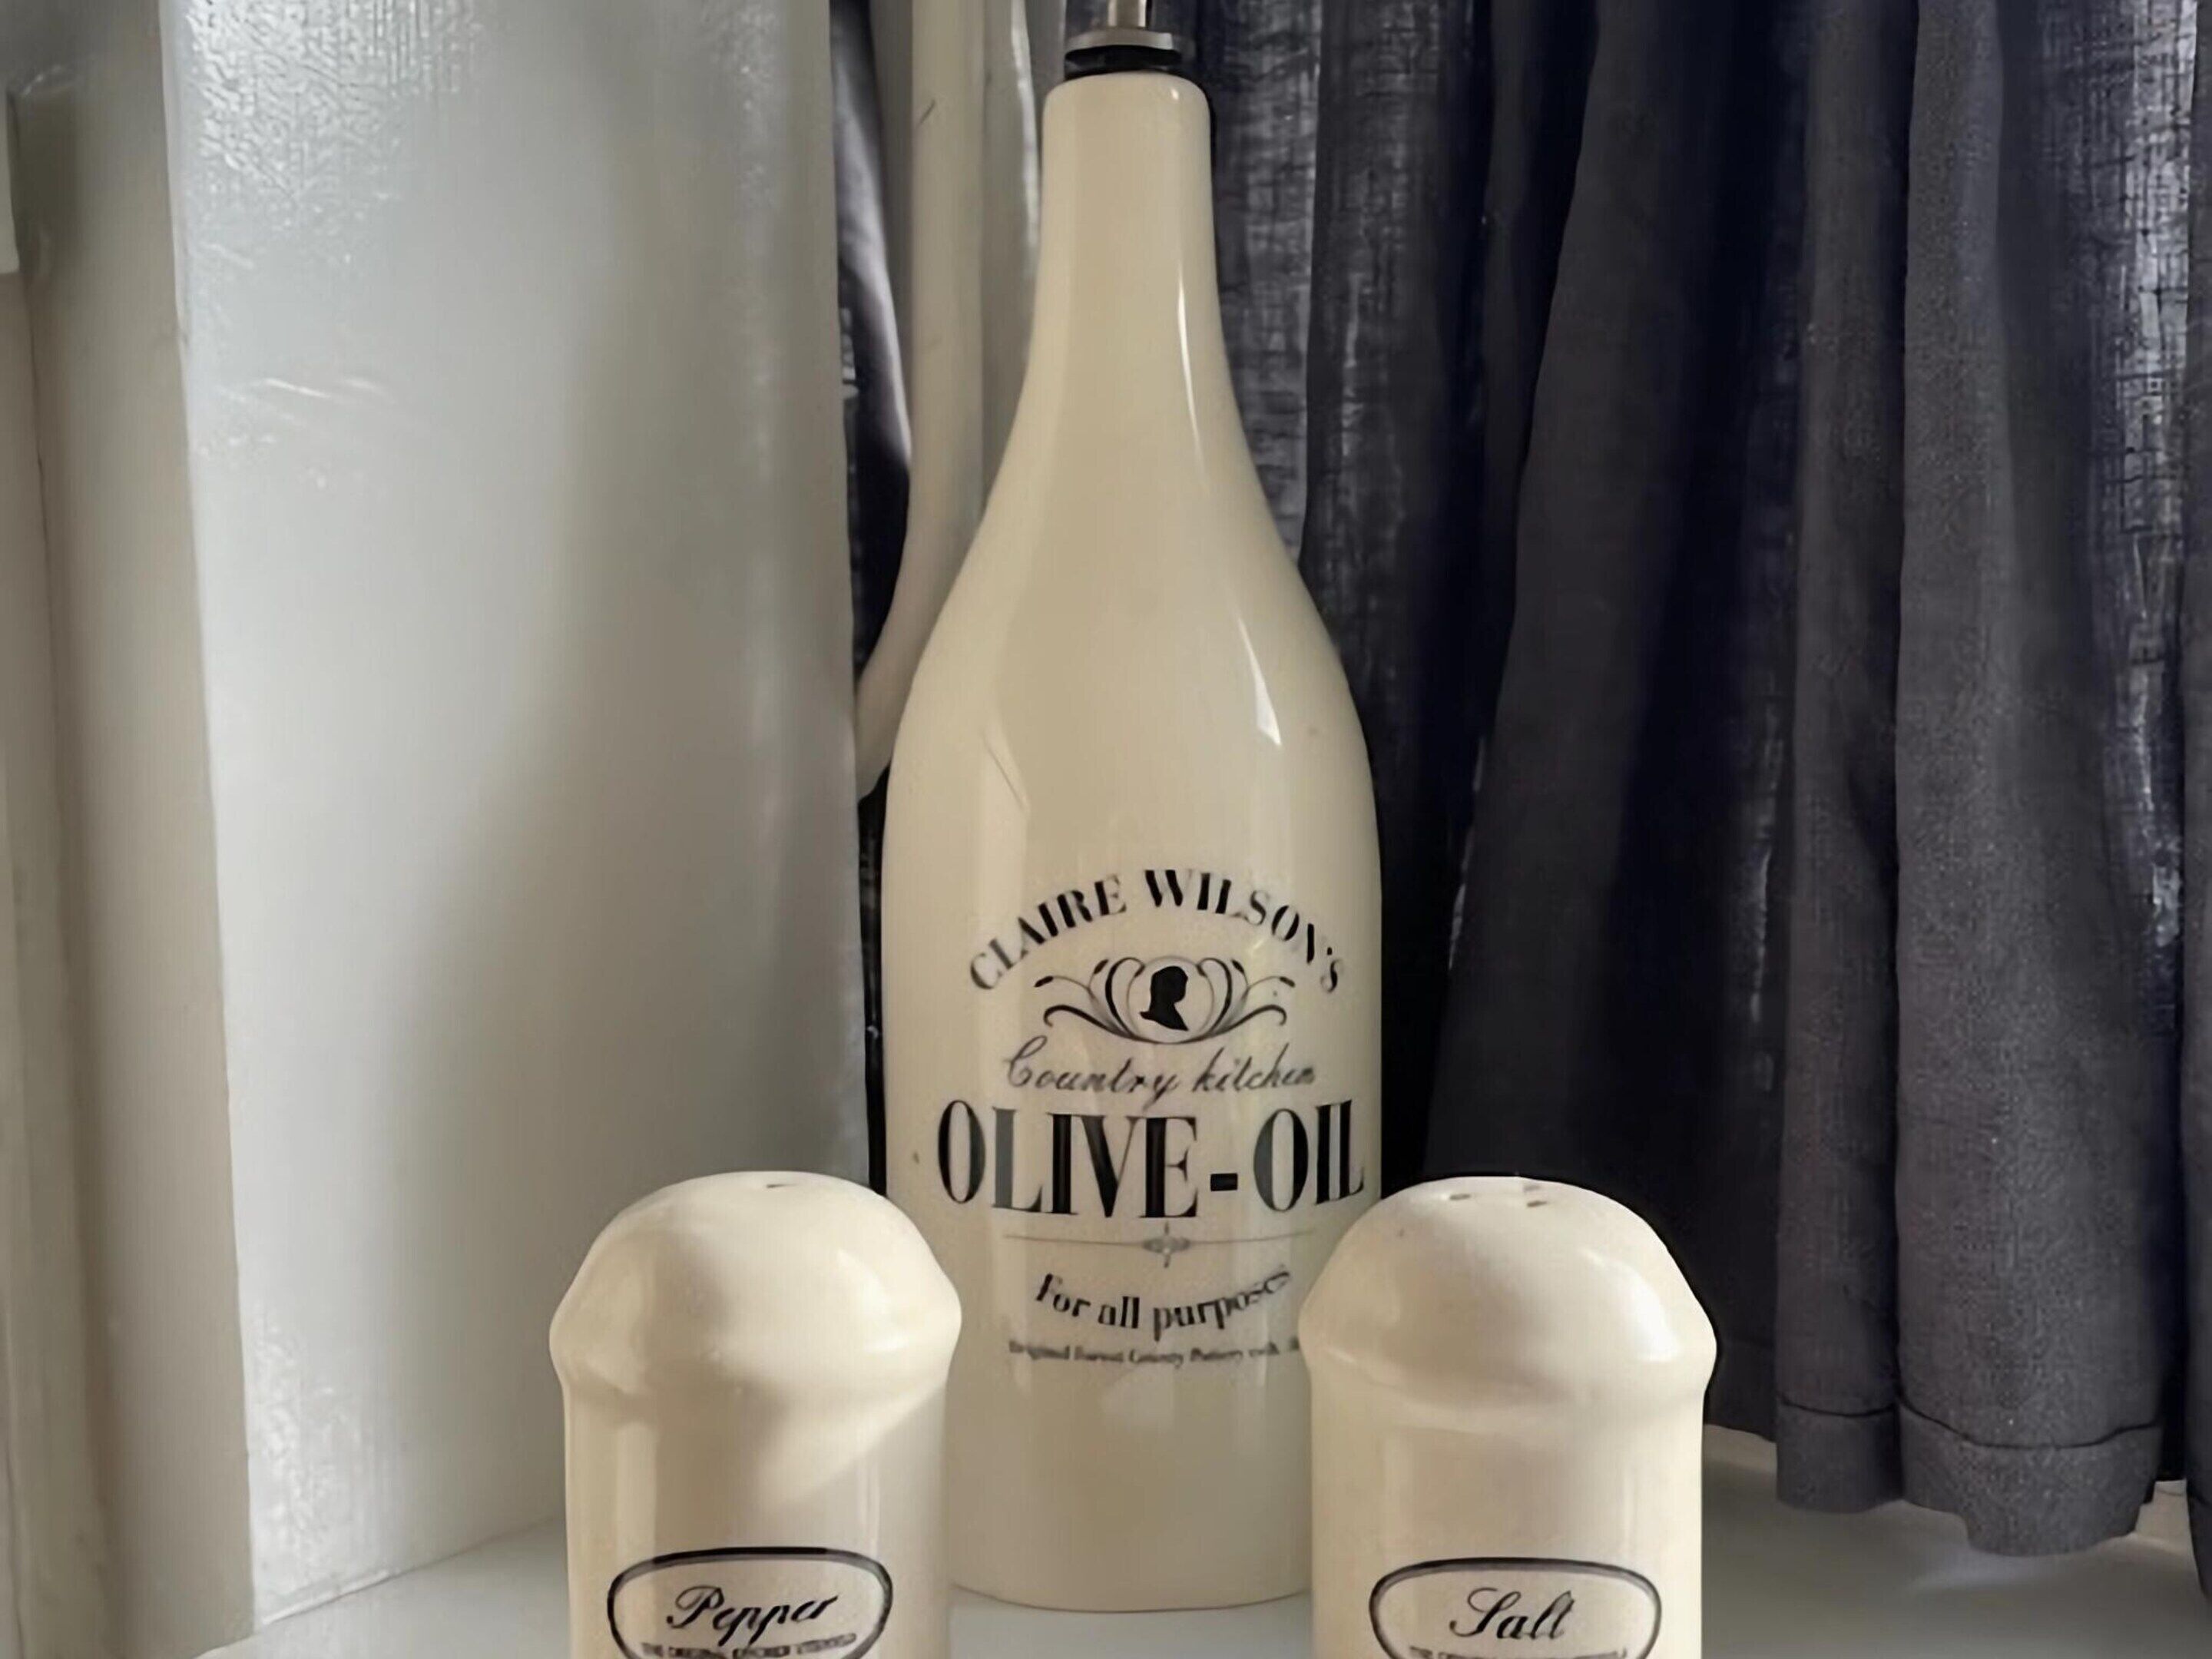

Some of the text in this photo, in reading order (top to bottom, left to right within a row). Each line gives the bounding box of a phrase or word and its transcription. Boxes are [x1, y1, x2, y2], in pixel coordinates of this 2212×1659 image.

[969, 875, 1128, 991] CLAIRE
[1005, 1035, 1316, 1111] Country kitchen
[937, 1099, 1366, 1218] OLIVE-OIL
[1035, 1273, 1091, 1317] For
[1097, 1296, 1140, 1329] all
[666, 1585, 839, 1647] Pepper
[1449, 1587, 1575, 1640] Salt
